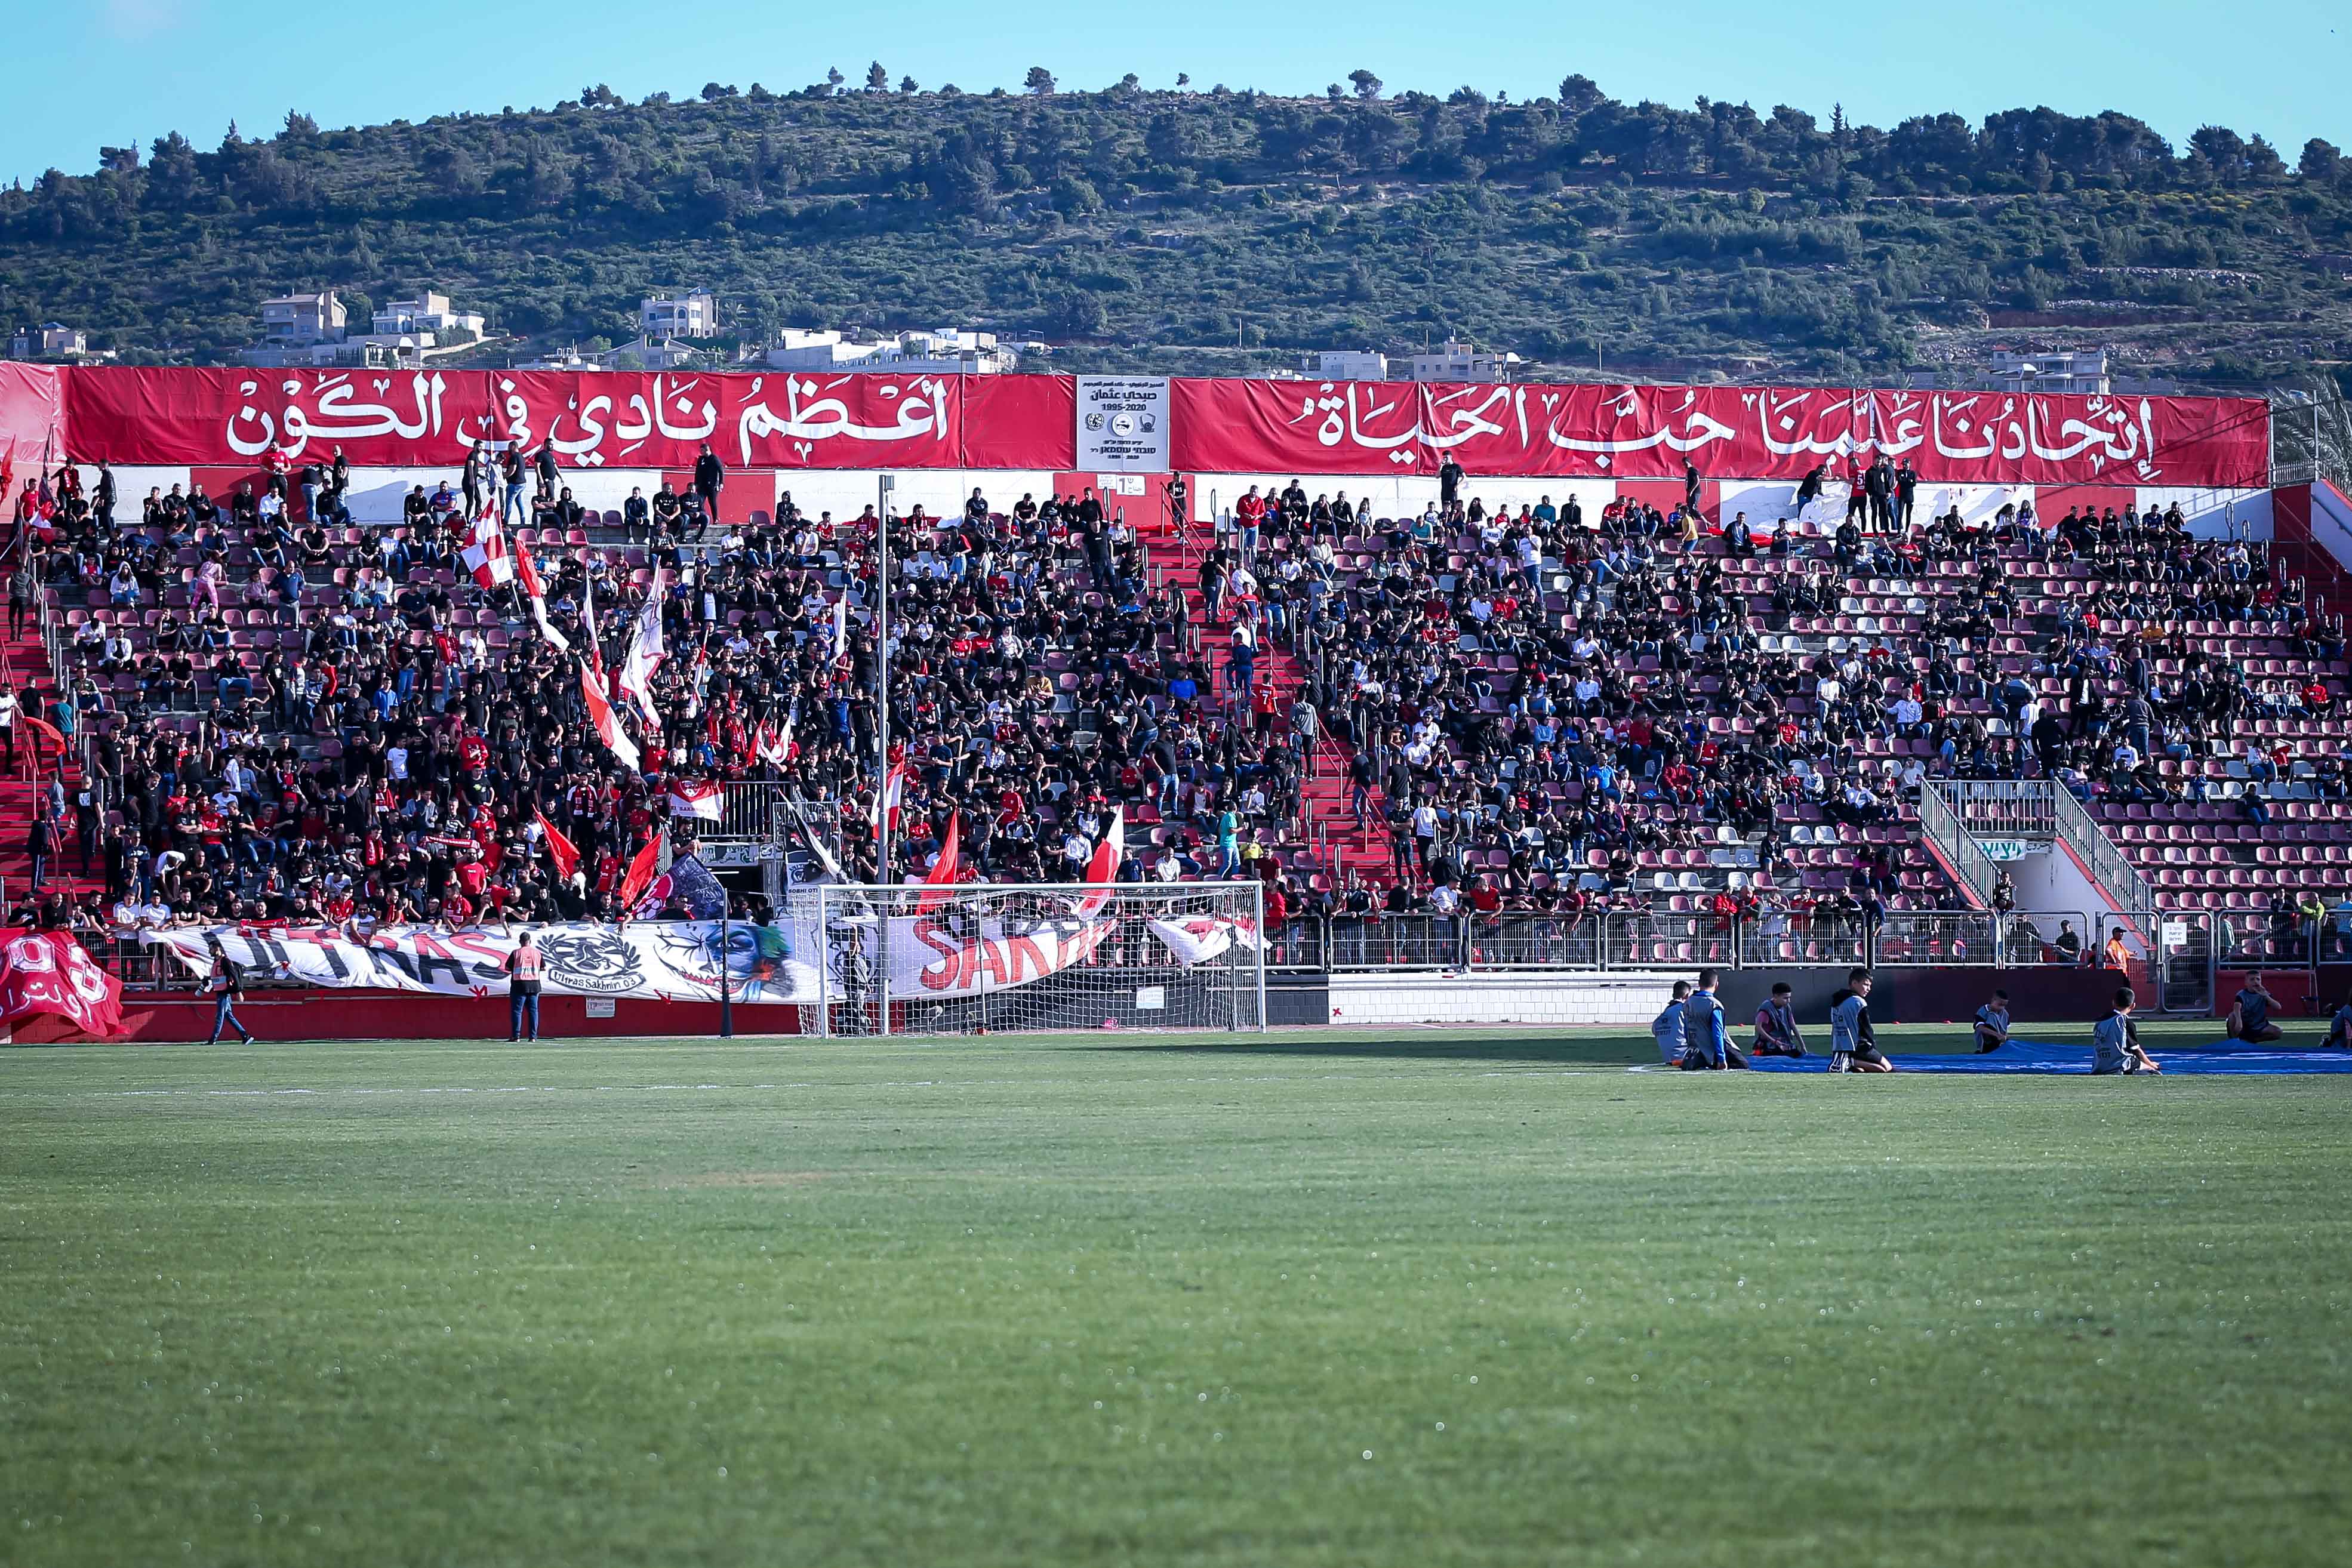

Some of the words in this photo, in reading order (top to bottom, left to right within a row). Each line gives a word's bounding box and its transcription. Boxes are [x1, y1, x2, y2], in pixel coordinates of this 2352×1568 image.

[1089, 388, 1121, 401] عثمان
[554, 971, 584, 986] Ultras
[585, 978, 621, 990] Sakhnin
[623, 977, 636, 988] 03
